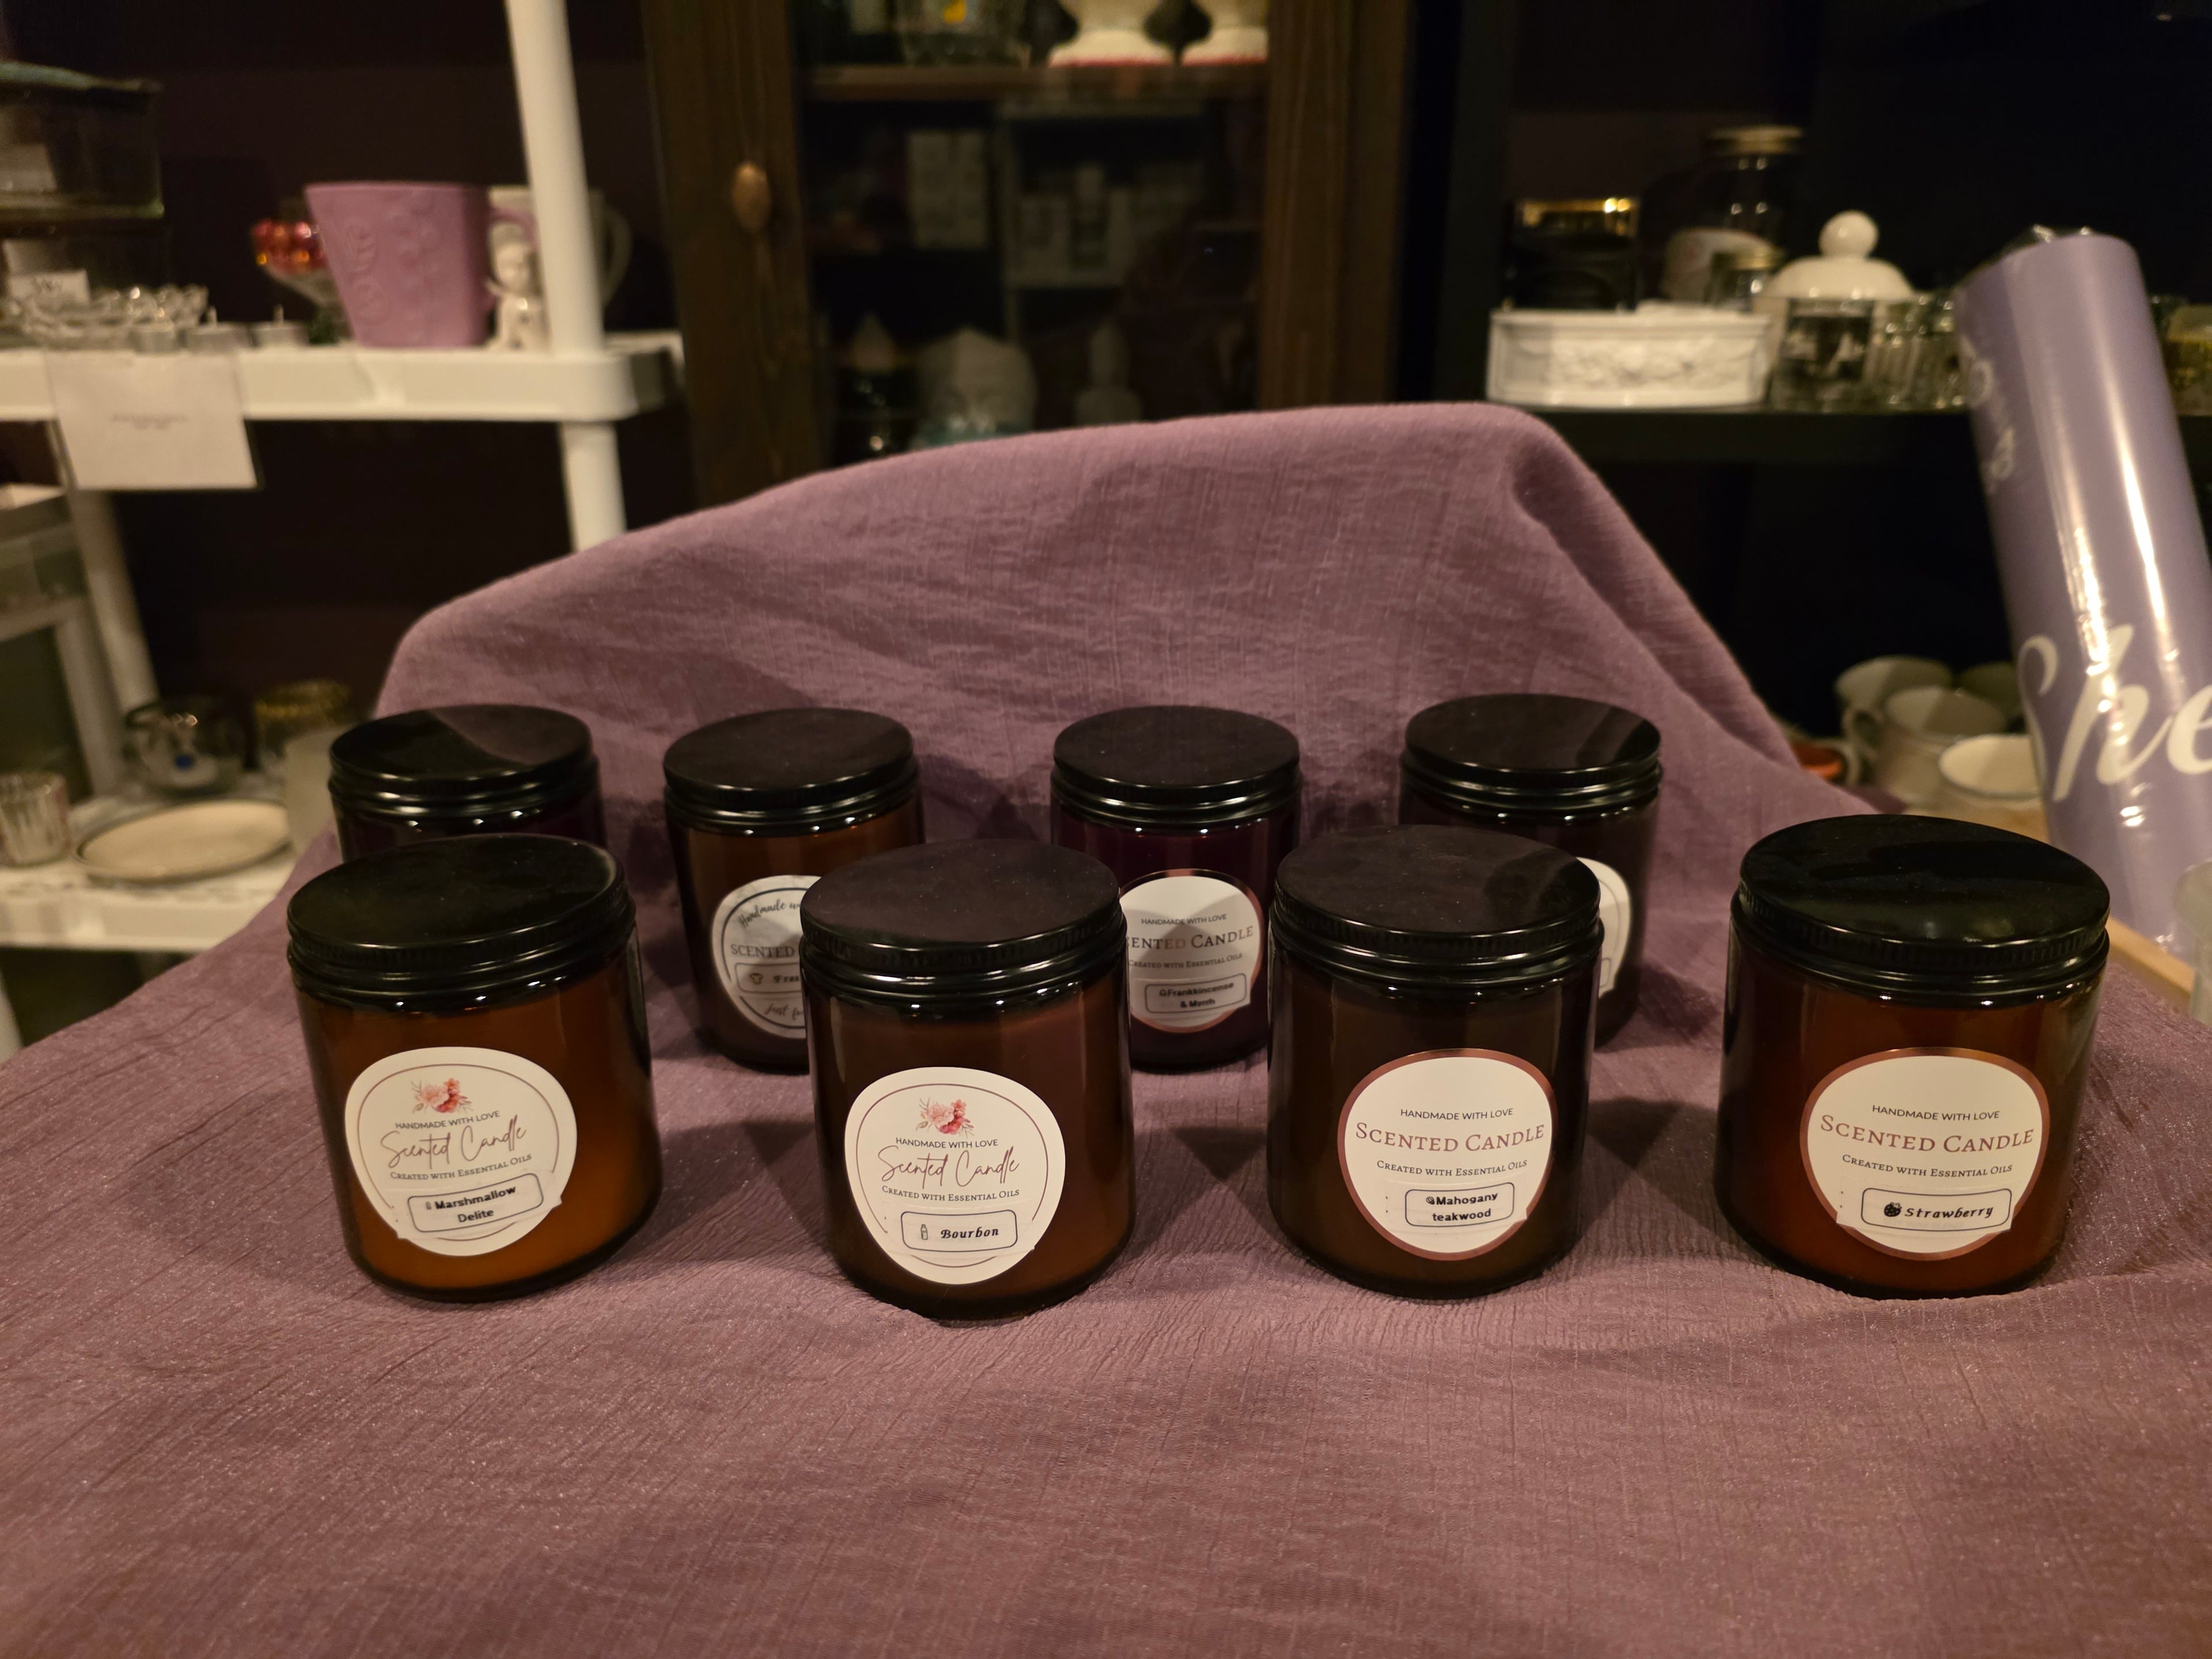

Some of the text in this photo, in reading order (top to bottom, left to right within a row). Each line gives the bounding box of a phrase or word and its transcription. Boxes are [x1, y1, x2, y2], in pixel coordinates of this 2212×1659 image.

[1187, 917, 1207, 925] WITH
[1209, 914, 1228, 922] LOVE
[730, 944, 795, 957] SCENTED
[395, 1110, 501, 1130] HANDMADE WITH LOVE
[1400, 1108, 1514, 1120] HANDMADE WITH LOVE
[1872, 1104, 2000, 1122] HANDMADE WITH LOVE
[380, 1114, 527, 1169] Scented Candle
[1355, 1122, 1546, 1152] SCENTED CANDLE
[1820, 1114, 2035, 1153] SCENTED CANDLE
[895, 1137, 999, 1149] HANDMADE WITH LOVE
[390, 1153, 532, 1181] CREATED WITH ESSENTIAL OILS
[877, 1145, 1020, 1190] Scented Candle
[1376, 1159, 1528, 1176] CREATED WITH ESSENTIAL OILS
[1842, 1153, 2013, 1178] CREATED WITH ESSENTIAL OILS
[434, 1186, 517, 1210] Marshmallow
[881, 1185, 1020, 1202] CREATED WITH ESSENTIAL OILS
[1435, 1192, 1498, 1206] Mahogany
[457, 1209, 494, 1223] Delite
[1432, 1208, 1491, 1222] teakwood
[1904, 1206, 1994, 1218] Strawberry
[940, 1226, 999, 1239] Bourbon
